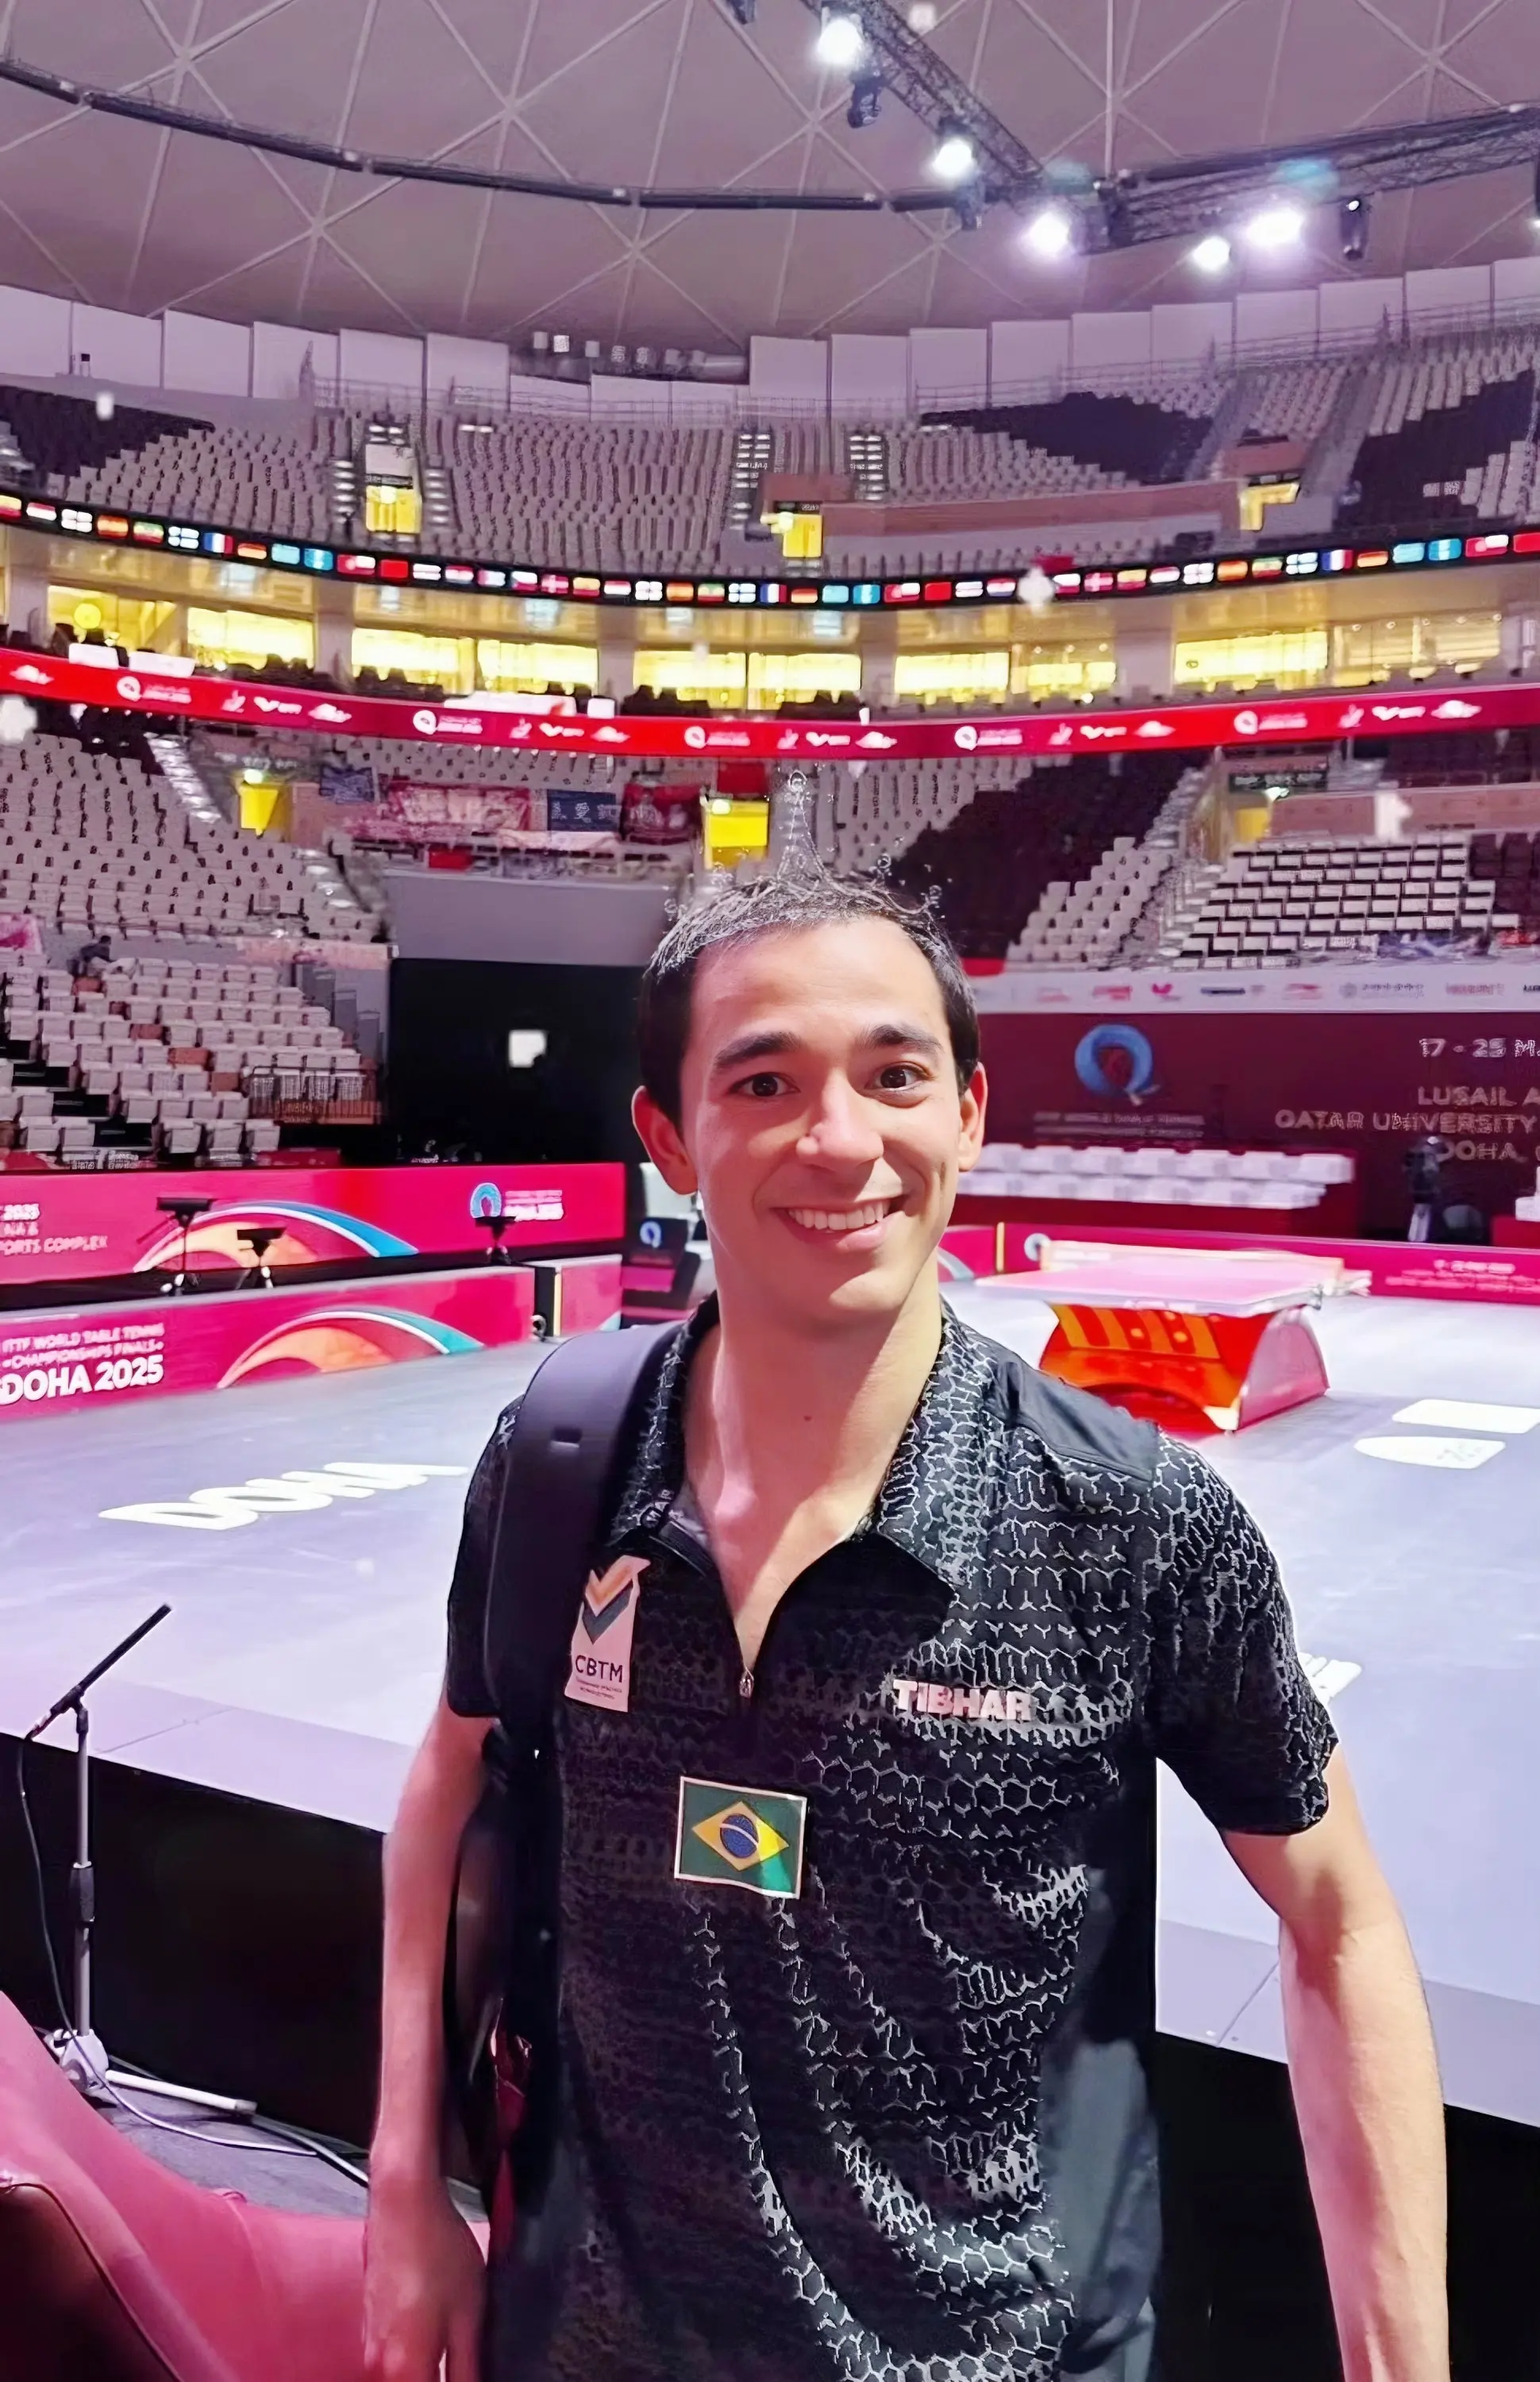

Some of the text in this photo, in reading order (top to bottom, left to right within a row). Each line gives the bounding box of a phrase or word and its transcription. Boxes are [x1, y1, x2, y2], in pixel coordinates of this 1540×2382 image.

[1419, 1038, 1447, 1058] 17
[1473, 1037, 1507, 1058] 25
[1514, 1039, 1540, 1058] M
[1418, 1085, 1517, 1107] LUSAIL
[1373, 1112, 1538, 1134] UNIVERSITY
[44, 1235, 108, 1253] COMPLEX
[33, 1332, 81, 1350] WORLD
[83, 1327, 121, 1343] TABLE
[0, 1354, 164, 1405] DOHA 2025
[576, 1655, 623, 1683] CBTM
[893, 1679, 1033, 1721] TIBHAR
